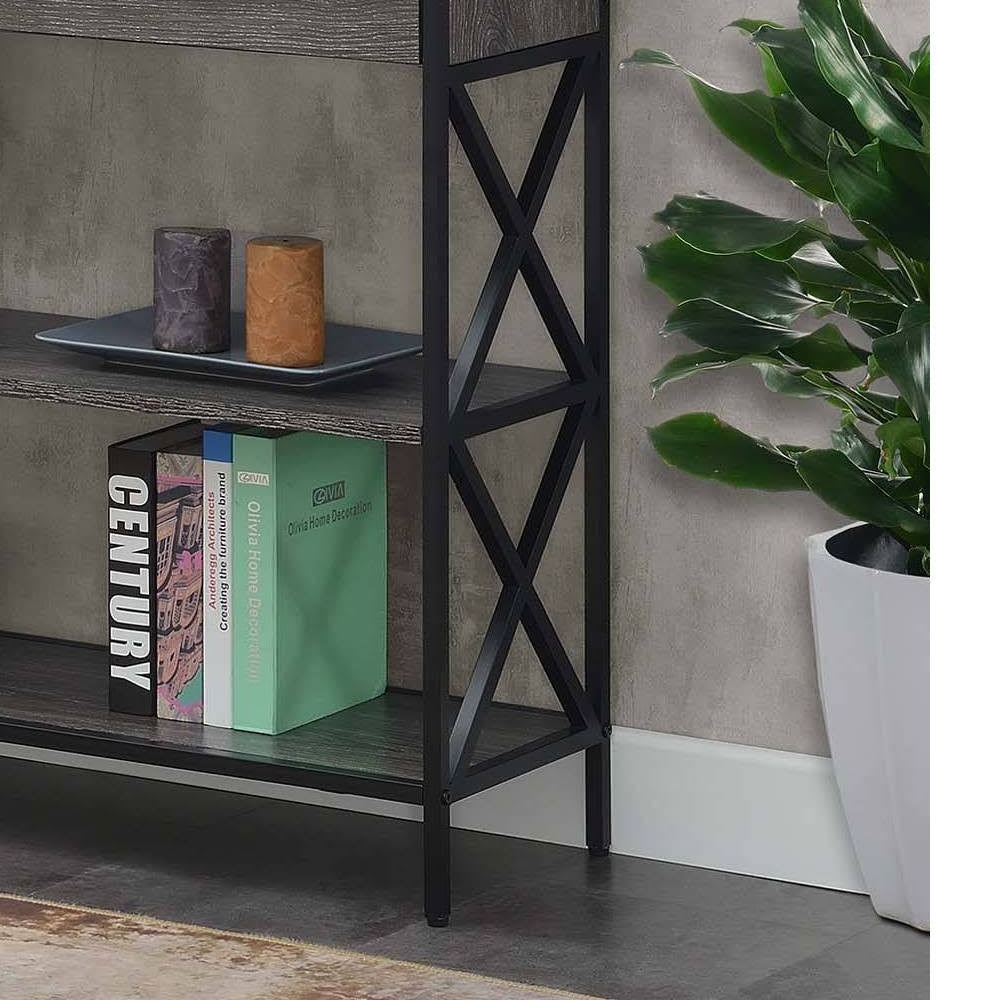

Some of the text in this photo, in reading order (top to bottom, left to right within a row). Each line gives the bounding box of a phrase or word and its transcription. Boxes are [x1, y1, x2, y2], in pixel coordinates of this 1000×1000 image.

[207, 491, 218, 610] Anderegg Architects
[217, 472, 229, 631] Creating the furniture brand
[247, 500, 260, 546] Olivia
[309, 513, 331, 530] Home
[331, 500, 373, 523] Decoration
[108, 474, 151, 691] CENTURY
[248, 549, 261, 593] Home
